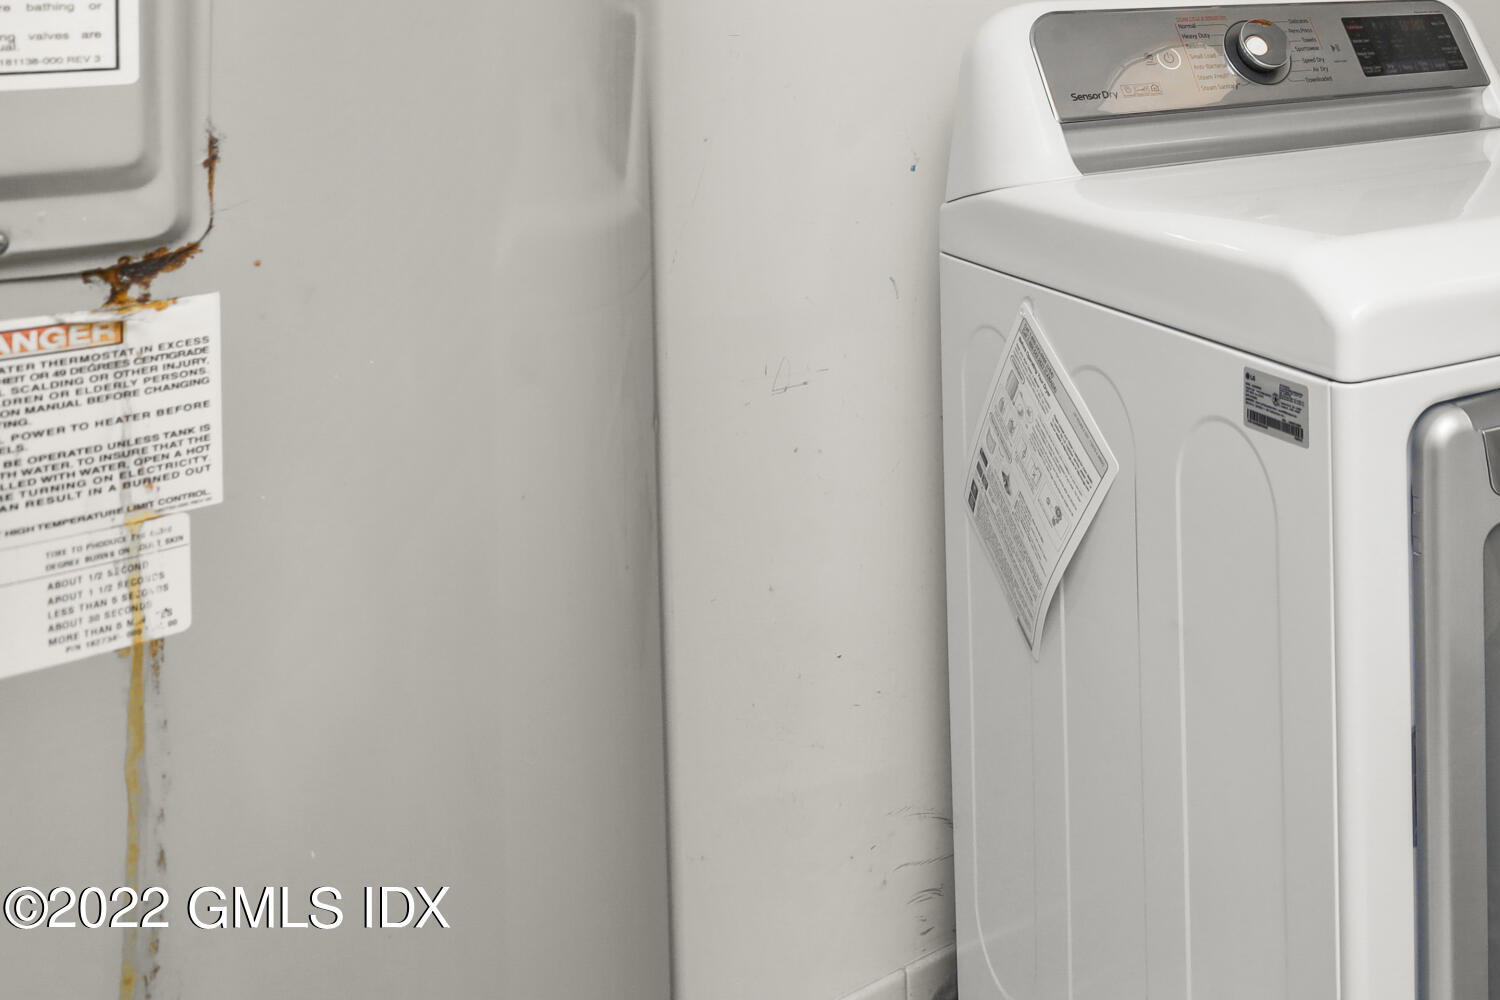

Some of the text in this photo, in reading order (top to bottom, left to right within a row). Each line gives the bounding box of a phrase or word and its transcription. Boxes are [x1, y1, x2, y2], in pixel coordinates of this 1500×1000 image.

[26, 3, 75, 13] bathing
[28, 32, 70, 41] valves
[30, 371, 49, 382] OR
[70, 358, 131, 376] DEGREES
[133, 346, 209, 365] CENTIGRADE
[41, 347, 135, 369] THERMOSTAT
[140, 345, 153, 354] IN
[158, 335, 210, 351] EXCESS
[11, 377, 84, 395] SCALDING
[89, 372, 109, 383] OR
[113, 364, 159, 380] OTHER
[49, 389, 70, 400] OR
[75, 379, 138, 396] ELDERLY
[24, 399, 82, 415] MANUAL
[86, 389, 140, 405] BEFORE
[144, 376, 210, 395] CHANGING
[11, 400, 210, 441] POWER TO HEATER BEFORE
[3, 424, 211, 469] BE OPERATED UNLESS TANK IS
[78, 456, 94, 466] TO
[99, 446, 149, 462] INSURE
[153, 440, 184, 452] THAT
[188, 433, 211, 445] THE
[40, 471, 76, 484] WITH
[133, 453, 170, 467] OPEN
[174, 450, 182, 458] A
[186, 444, 211, 455] HOT
[20, 480, 87, 498] TURNING
[92, 474, 113, 485] ON
[25, 491, 82, 508] RESULT
[88, 487, 102, 496] IN
[108, 484, 117, 492] A
[122, 472, 180, 489] BURNED
[185, 464, 212, 477] OUT
[4, 526, 35, 537] HIGH
[38, 507, 124, 530] TEMPERATURE
[127, 501, 154, 513] LIMIT
[47, 575, 83, 591] ABOUT
[89, 571, 103, 581] 1/2
[47, 591, 83, 606] ABOUT
[99, 584, 113, 594] 1/2
[47, 606, 74, 620] LESS
[80, 599, 108, 612] THAN
[48, 617, 83, 633] ABOUT
[48, 632, 79, 646] MORE
[84, 623, 112, 637] THAN
